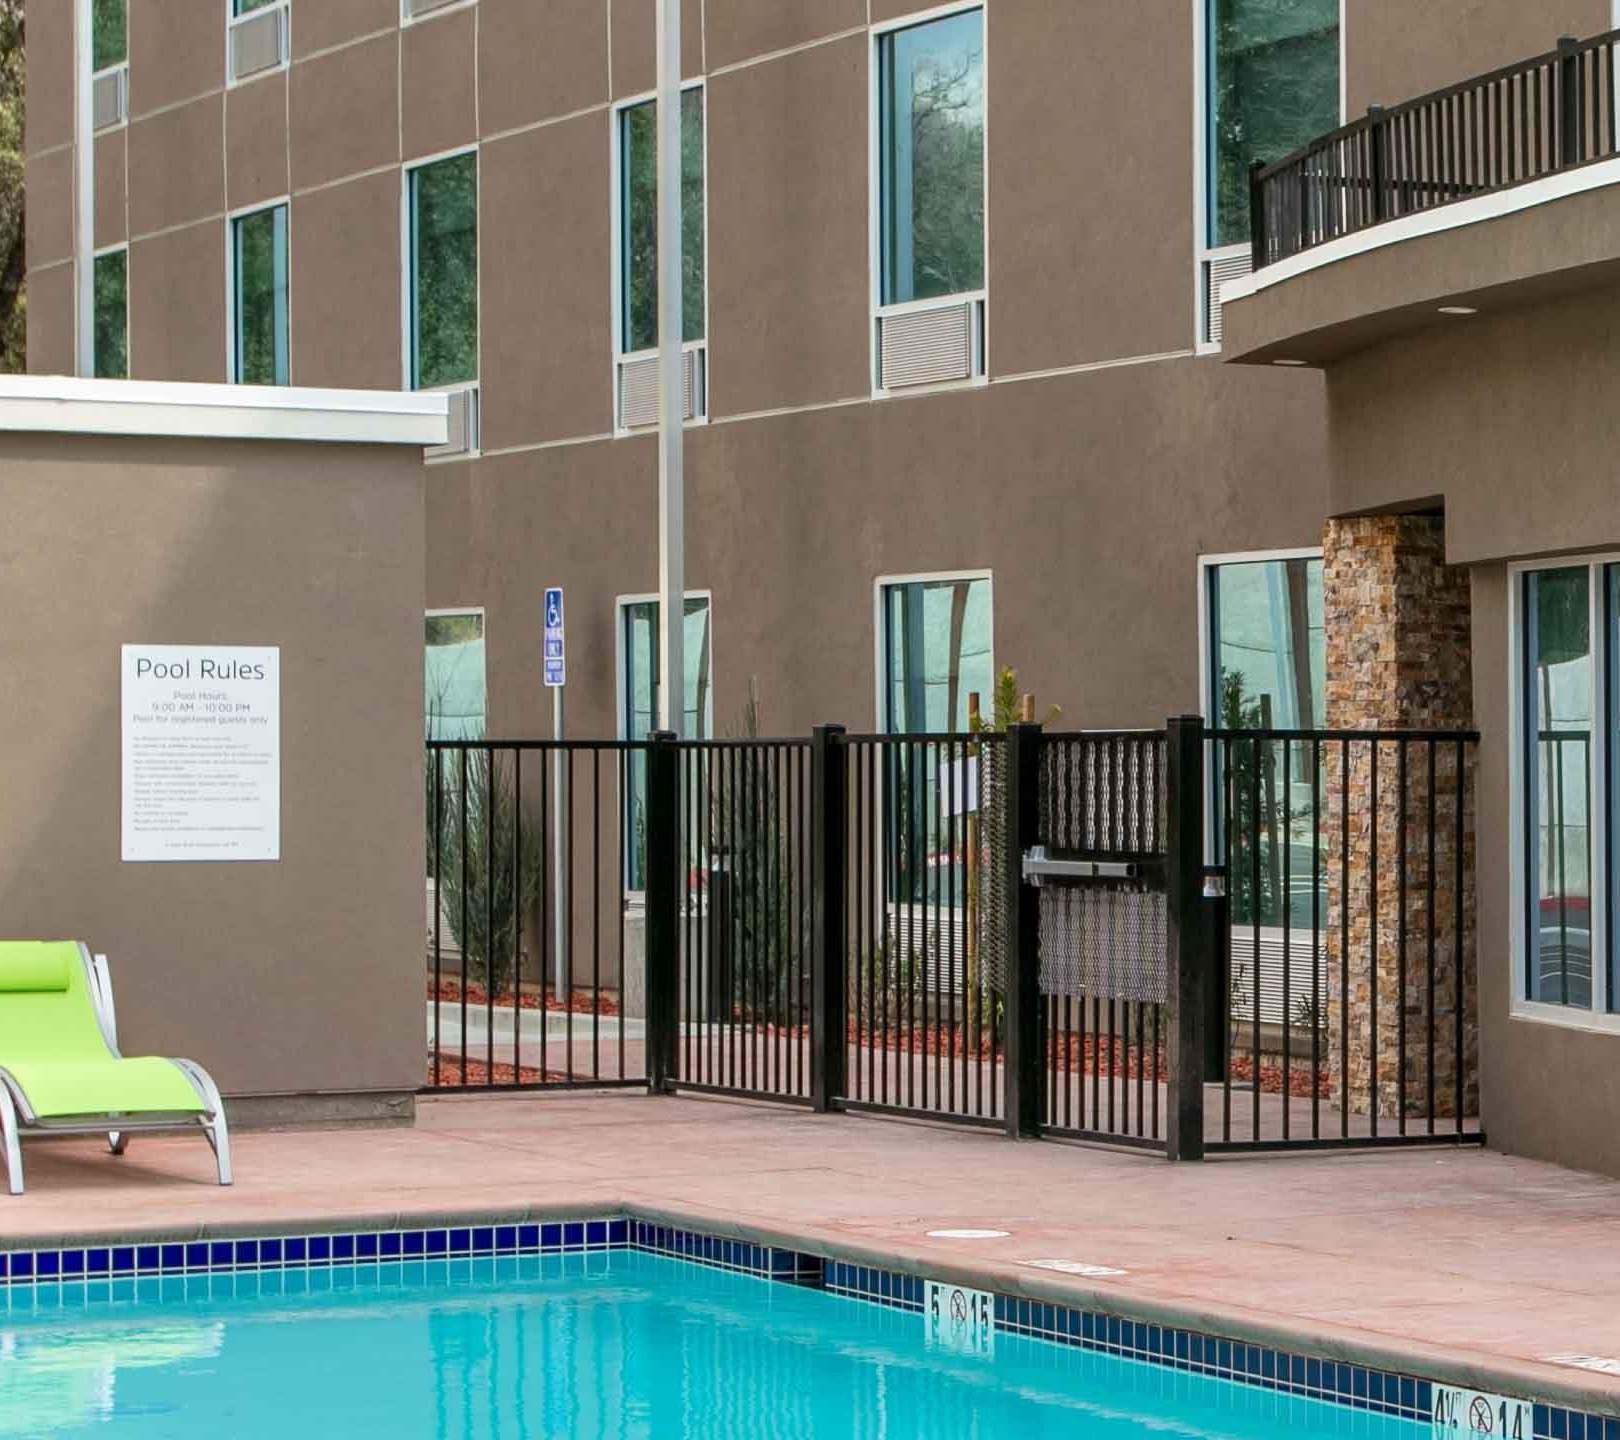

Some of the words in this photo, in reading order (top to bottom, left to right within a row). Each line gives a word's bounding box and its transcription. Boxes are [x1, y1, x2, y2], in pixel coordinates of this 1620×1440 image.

[136, 657, 190, 679] Pool
[200, 658, 265, 680] Rules
[931, 1284, 940, 1317] 5
